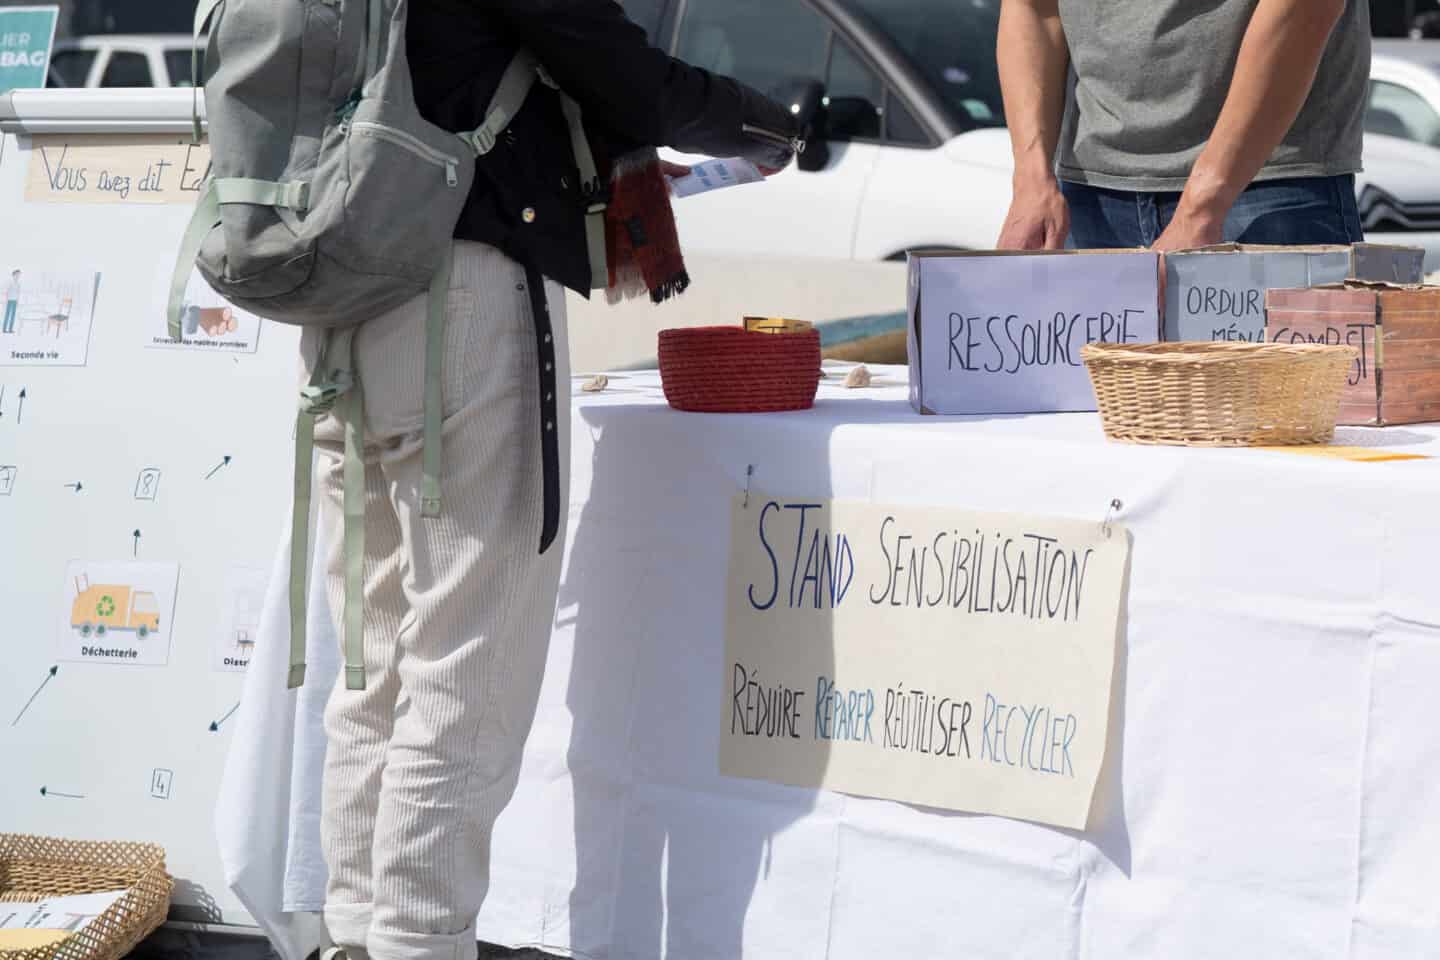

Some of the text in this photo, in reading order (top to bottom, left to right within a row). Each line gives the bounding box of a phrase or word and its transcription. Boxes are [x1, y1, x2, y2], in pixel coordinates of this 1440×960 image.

[138, 159, 172, 192] dit
[1186, 286, 1258, 318] ORDUR
[11, 350, 59, 360] Seconde vie
[81, 645, 138, 660] Déchetterie
[223, 656, 250, 668] Distr
